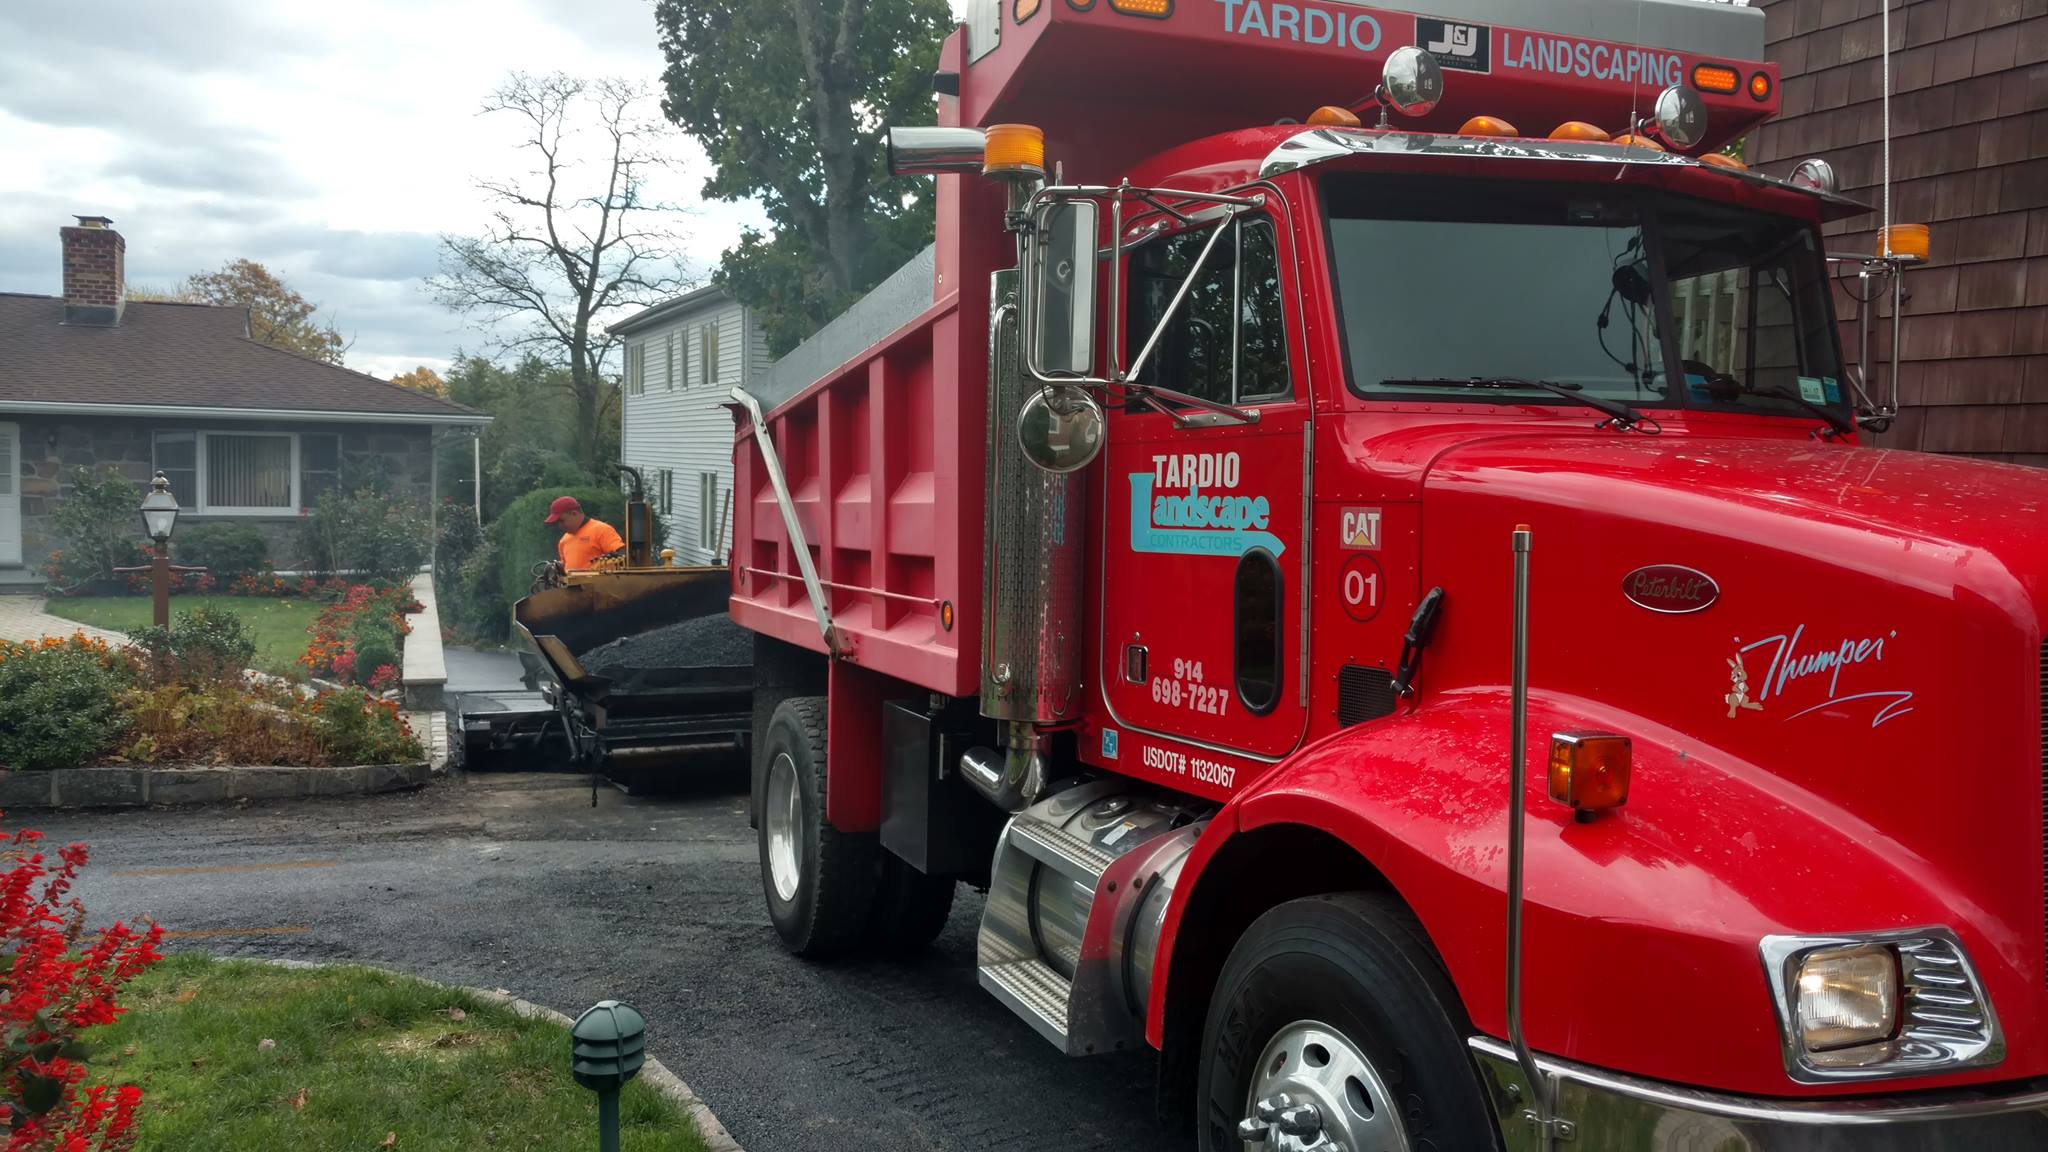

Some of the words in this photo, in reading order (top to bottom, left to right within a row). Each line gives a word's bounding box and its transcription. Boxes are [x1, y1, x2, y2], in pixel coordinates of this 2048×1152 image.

[1215, 0, 1382, 51] TARDIO
[1428, 23, 1477, 56] J&J
[1503, 32, 1682, 87] LANDSCAPING
[1152, 451, 1240, 489] TARDIO
[1128, 473, 1274, 552] Landscape
[1343, 512, 1380, 545] CAT
[1150, 533, 1243, 551] CONTRACTORS
[1344, 570, 1377, 606] 01
[1632, 571, 1710, 601] Peterbilt
[1174, 657, 1203, 682] 914
[1152, 676, 1229, 716] 698-7227
[1143, 745, 1187, 775] USDOT#
[1190, 757, 1236, 788] 1132067
